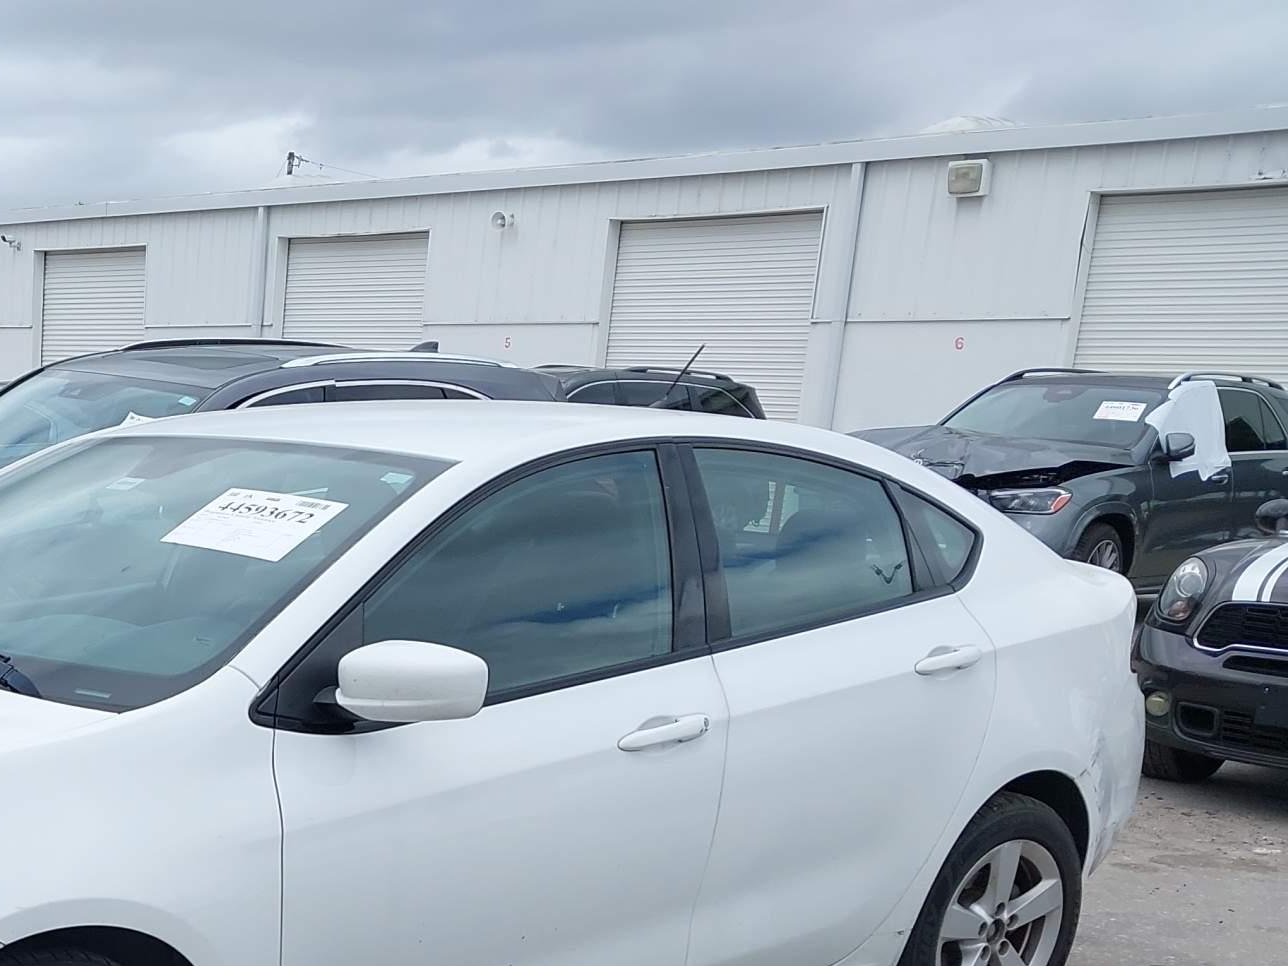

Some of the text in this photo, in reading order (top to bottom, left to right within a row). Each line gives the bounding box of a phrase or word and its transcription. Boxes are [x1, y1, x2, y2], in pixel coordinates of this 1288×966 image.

[504, 336, 512, 349] 5
[954, 336, 965, 351] 6
[218, 501, 315, 524] 44593672
